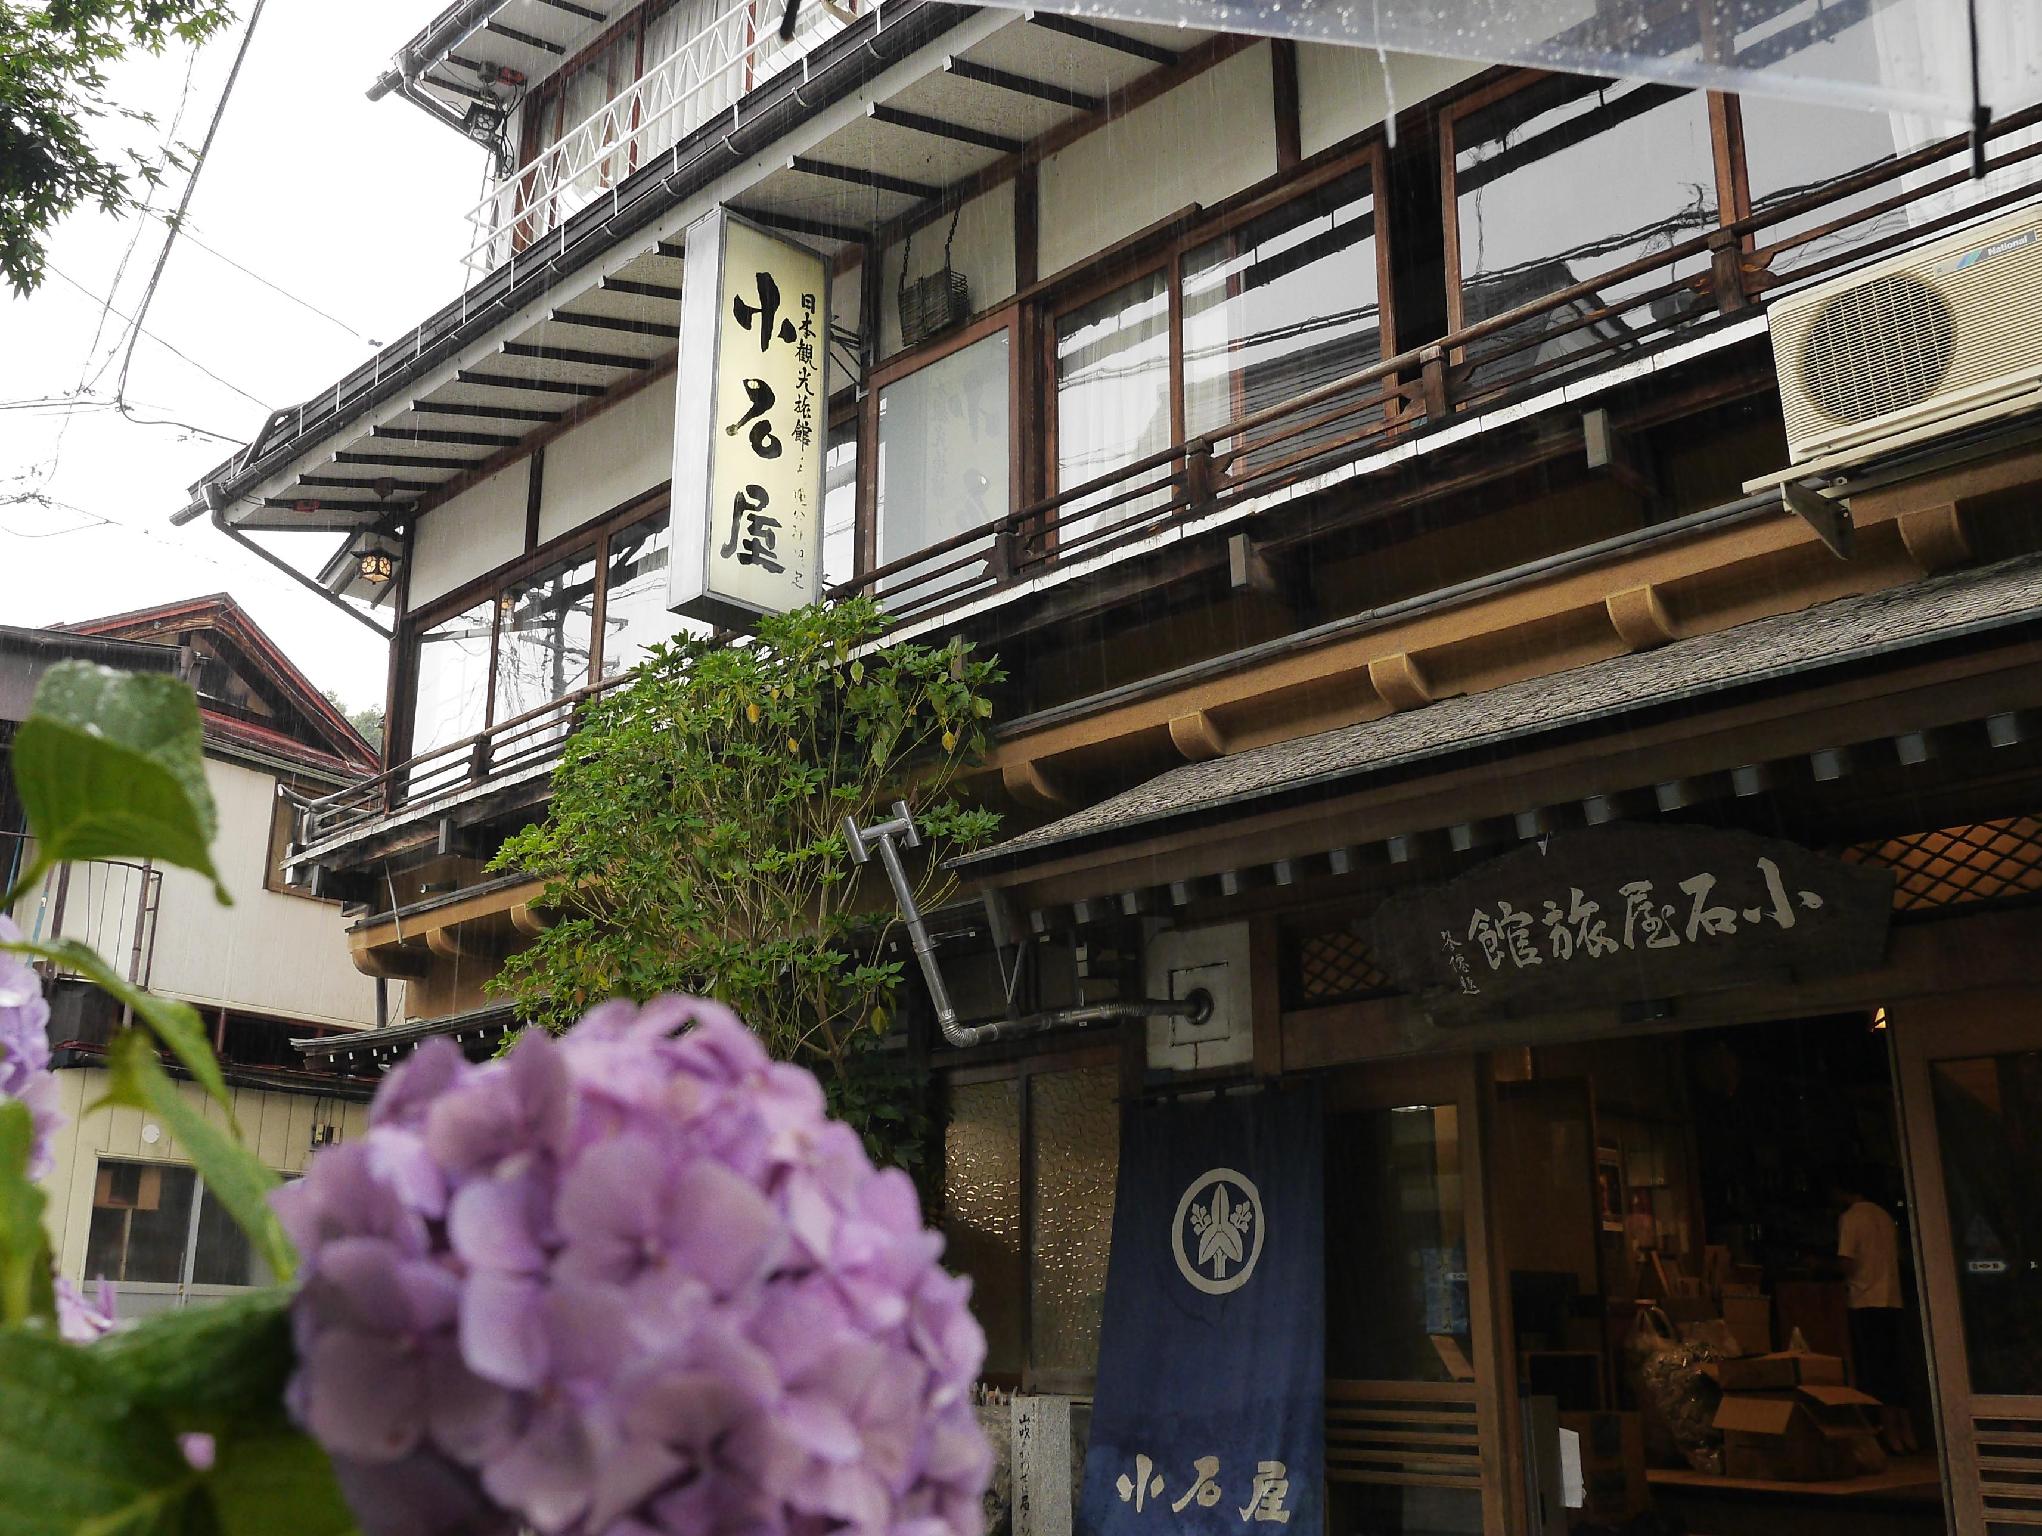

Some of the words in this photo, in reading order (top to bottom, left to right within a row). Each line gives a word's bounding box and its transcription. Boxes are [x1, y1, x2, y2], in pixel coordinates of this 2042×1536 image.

[1987, 235, 2028, 256] National
[720, 271, 797, 576] 小石屋
[1467, 856, 1823, 970] 小石屋旅館
[1116, 1453, 1291, 1523] 小石屋
